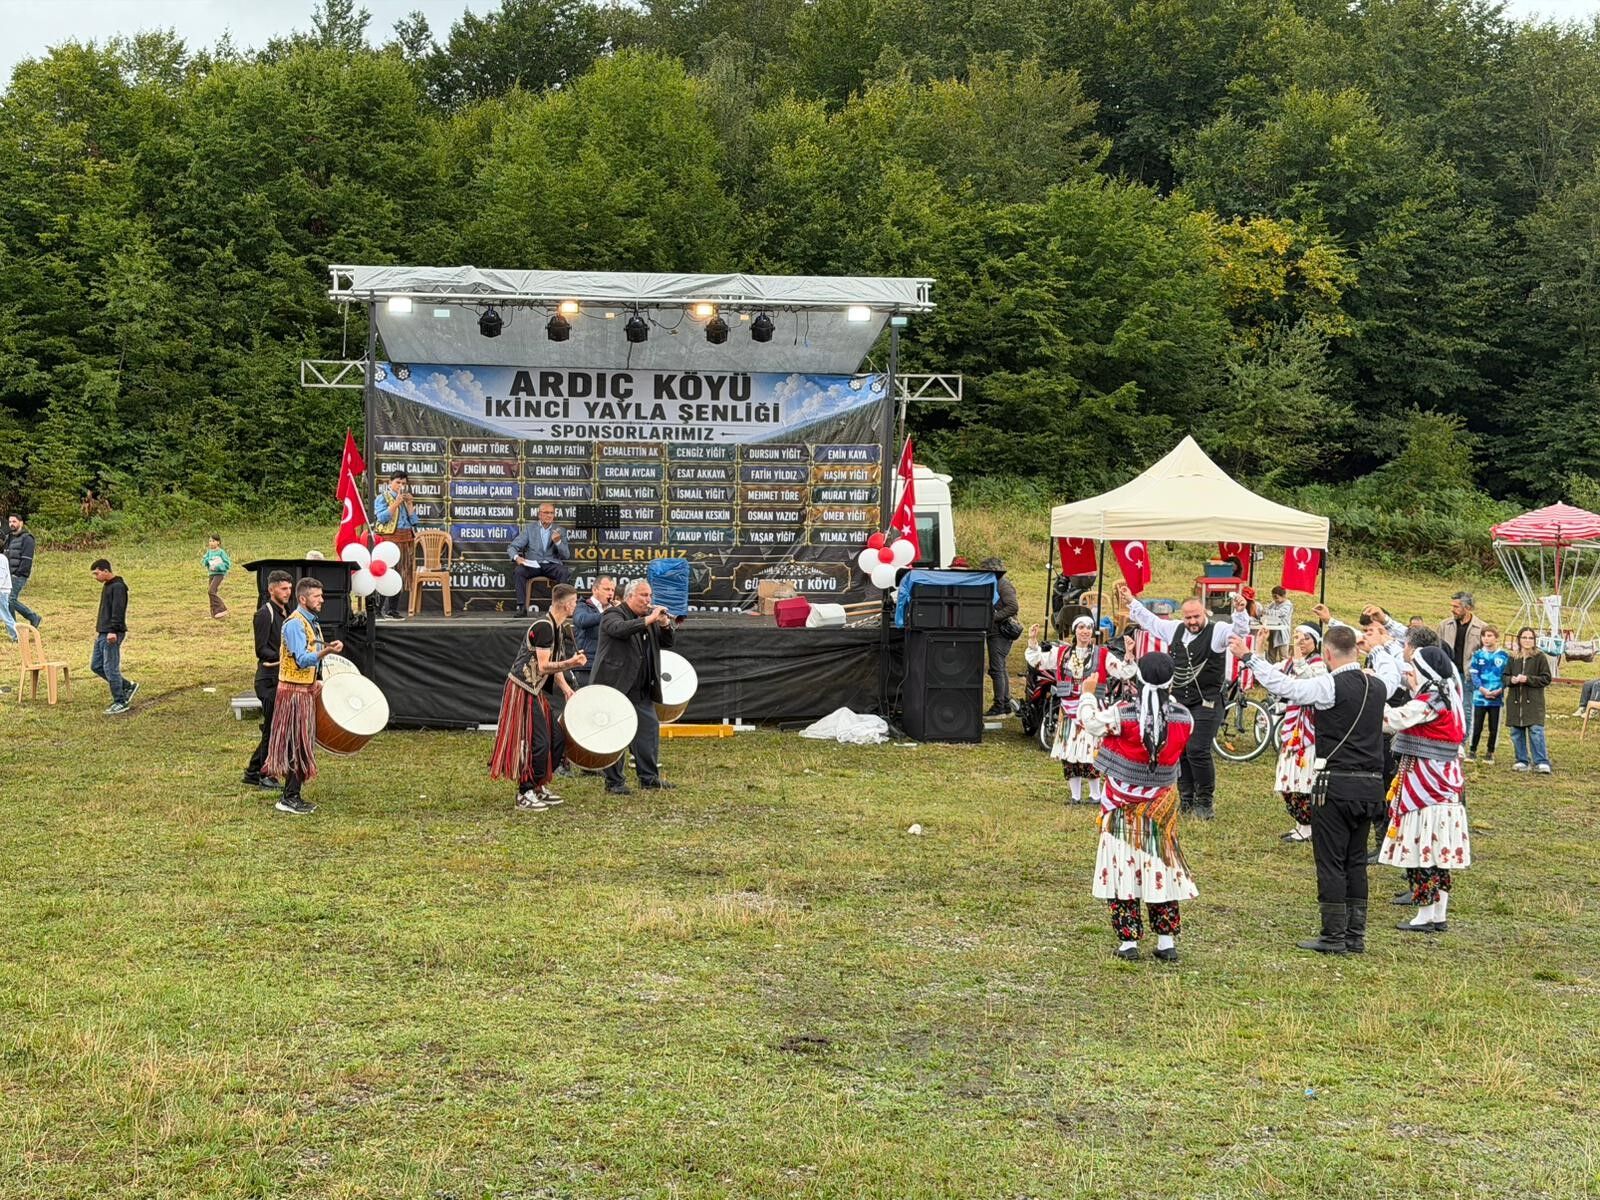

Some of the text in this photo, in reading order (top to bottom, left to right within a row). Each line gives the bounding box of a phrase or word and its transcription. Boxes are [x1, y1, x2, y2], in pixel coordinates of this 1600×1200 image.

[509, 370, 751, 402] ARDIÇ KÖYÜ
[485, 396, 780, 424] İKİNCİ YAYLA ŞENLİĞİ
[551, 424, 714, 441] SPONSORLARIMIZ
[383, 442, 436, 453] AHMET SEVEN
[461, 442, 510, 454] AHMET TÖRE
[532, 444, 585, 455] AR YAPI FATİH
[603, 446, 659, 457] CEMALETTİN AK
[676, 447, 726, 458] CENGİZ YİĞİT
[749, 448, 801, 459] DURSUN YİĞİT
[828, 448, 867, 460] EMİN KAYA
[381, 462, 405, 473] ENGİN
[464, 464, 506, 475] ENGİN MOL
[536, 464, 581, 477] ENGİN YİĞİT
[605, 467, 656, 478] ERCAN AYCAN
[677, 469, 726, 479] ESAT AKKAYA
[750, 468, 772, 480] FATİH
[849, 469, 869, 481] YİĞİT
[455, 484, 513, 498] İBRAHİM ÇAKIR
[534, 485, 584, 497] İSMAİL YİĞİT
[605, 486, 655, 498] İSMAİL YİĞİT
[676, 488, 726, 500] İSMAİL YİĞİT
[748, 490, 800, 501] MEHMET TÖRE
[821, 489, 869, 501] MURAT YİĞİT
[454, 505, 514, 517] MUSTAFA KESKİN
[634, 507, 654, 519] YİĞİT
[671, 508, 730, 520] OĞUZHAN KESKİN
[747, 511, 799, 521] OSMAN YAZICI
[846, 510, 867, 521] YİĞİT
[460, 527, 508, 539] RESUL YİĞİT
[566, 529, 588, 541] ÇAKIR
[604, 530, 653, 541] YAKUP KURT
[676, 530, 725, 542] YAKUP YİĞİT
[750, 531, 796, 543] YAŞAR YİĞİT
[819, 531, 869, 542] YILMAZ YİĞİT
[574, 546, 688, 560] KÖYLERİMİZ
[472, 574, 506, 588] KÖYÜ
[807, 577, 837, 590] KÖYÜ
